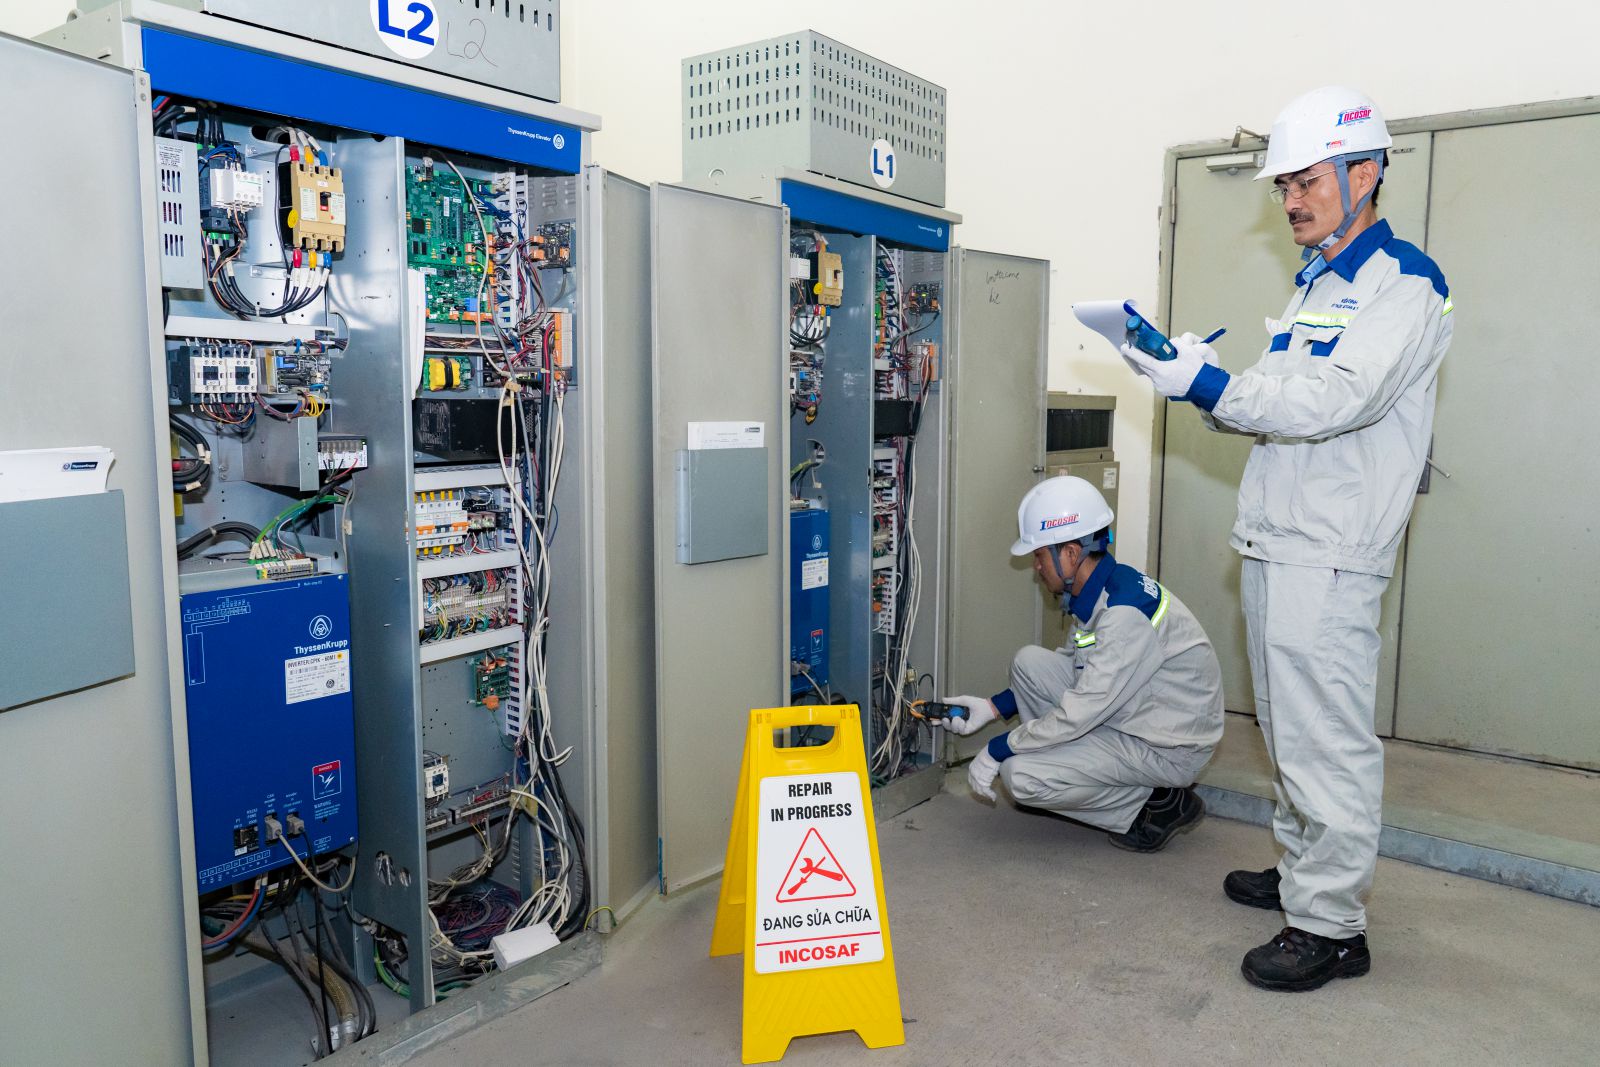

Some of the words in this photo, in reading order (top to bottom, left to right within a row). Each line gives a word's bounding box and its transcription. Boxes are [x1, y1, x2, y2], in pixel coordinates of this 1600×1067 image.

[378, 0, 435, 46] L2
[873, 148, 894, 179] L1
[294, 640, 348, 654] ThyssenKrupp
[788, 782, 832, 797] REPAIR
[771, 808, 784, 822] IN
[788, 803, 852, 821] PROGRESS
[763, 915, 803, 931] ĐANG
[807, 908, 832, 926] SỬA
[835, 906, 872, 924] CHỮA
[779, 943, 860, 964] INCOSAF
